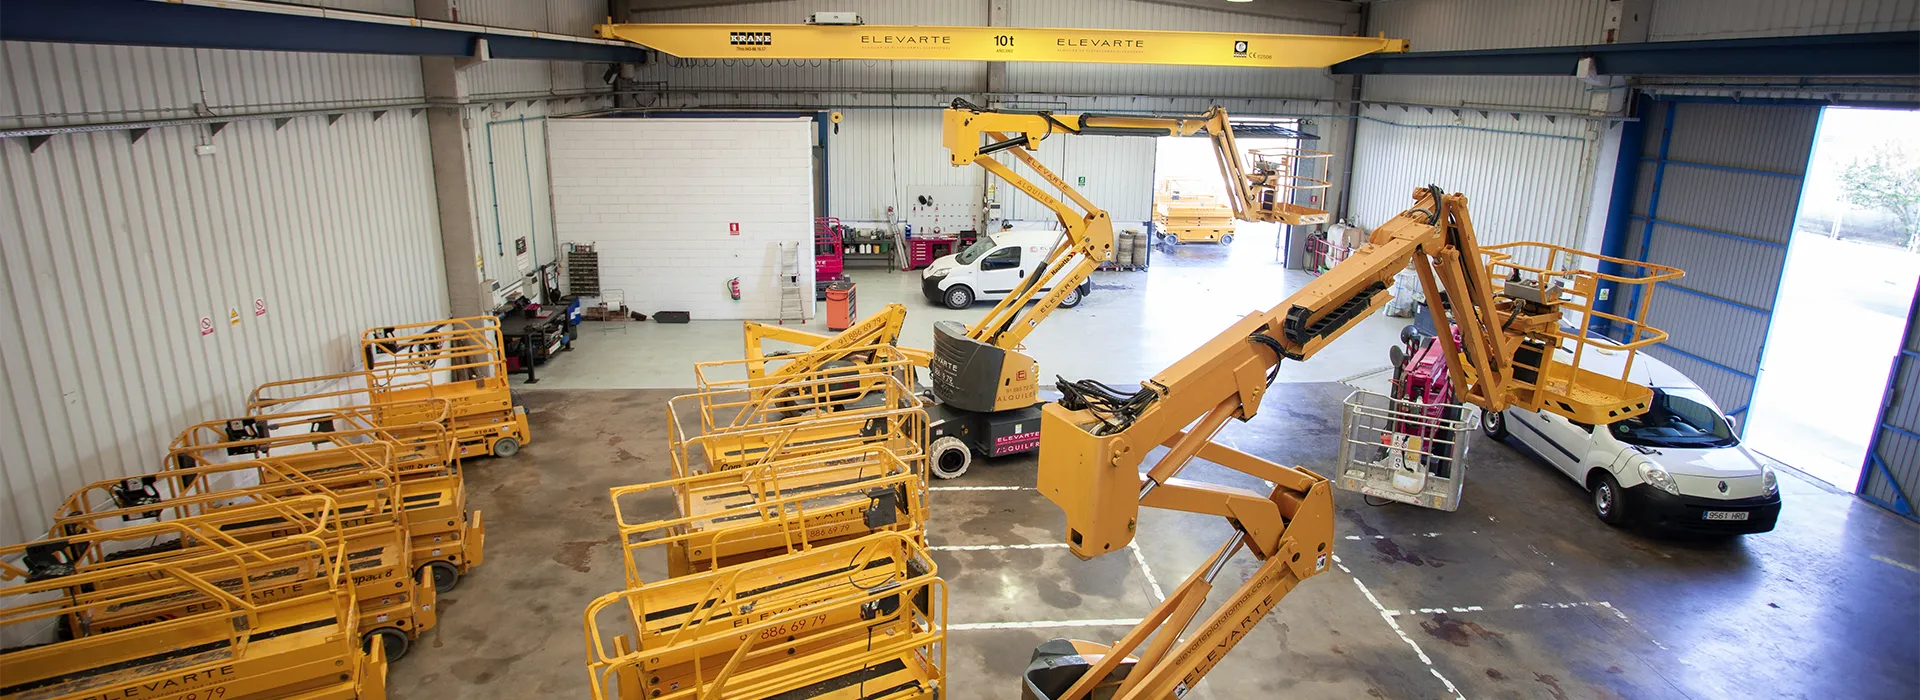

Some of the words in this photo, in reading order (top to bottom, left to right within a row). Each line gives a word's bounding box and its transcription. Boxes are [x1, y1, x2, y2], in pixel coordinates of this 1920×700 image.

[731, 34, 771, 44] KRANE
[861, 36, 950, 44] ELEVARTE
[994, 36, 1007, 46] 10
[1010, 36, 1014, 46] t
[1057, 38, 1144, 48] ELEVARTE
[1026, 156, 1068, 192] ELEVARTE
[1016, 180, 1054, 205] ALQUILER
[1040, 274, 1080, 313] ELEVARTE
[838, 336, 848, 345] 91
[848, 330, 862, 342] 886
[864, 323, 872, 332] 69
[874, 316, 880, 326] 79
[998, 432, 1040, 442] ELEVARTE
[810, 529, 826, 538] 886
[828, 526, 838, 534] 69
[840, 524, 850, 532] 79
[1176, 575, 1270, 666] elevarteplataformas.com
[761, 626, 786, 640] 886
[790, 619, 806, 632] 69
[1184, 594, 1273, 684] ELEVARTE
[203, 686, 226, 700] 79
